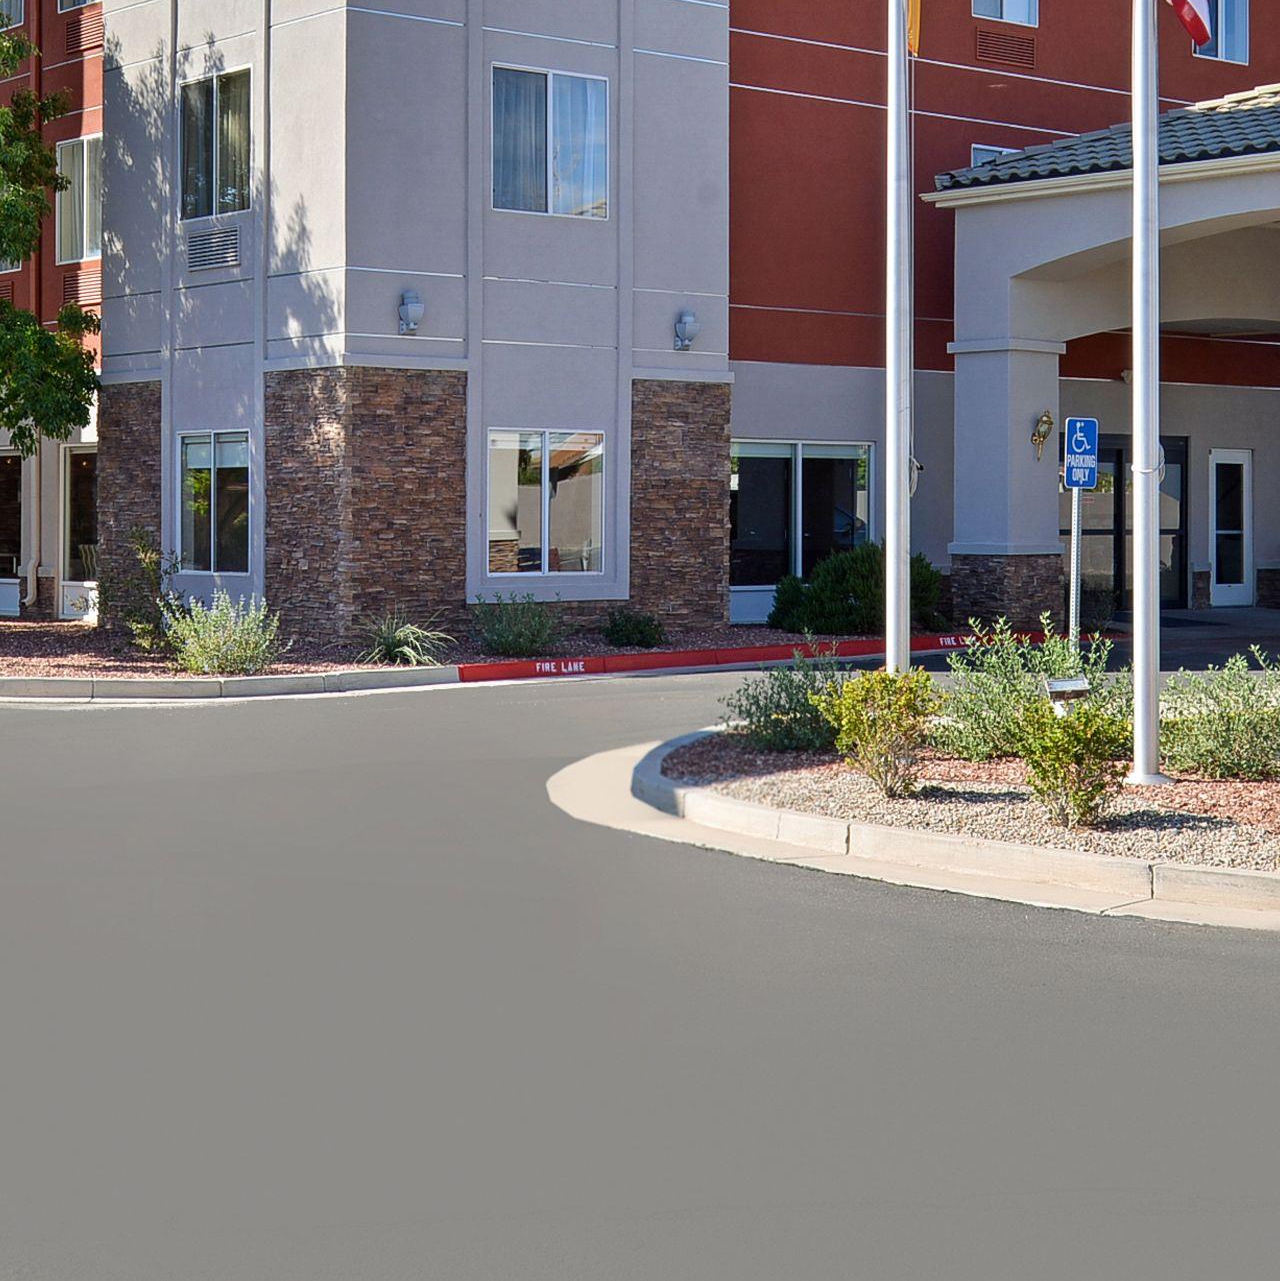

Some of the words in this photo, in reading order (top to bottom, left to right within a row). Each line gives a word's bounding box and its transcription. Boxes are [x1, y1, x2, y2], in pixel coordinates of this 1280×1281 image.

[1067, 454, 1096, 468] PARKING
[1072, 468, 1090, 481] ONLY
[536, 662, 557, 672] FIRE
[561, 661, 585, 672] LANE
